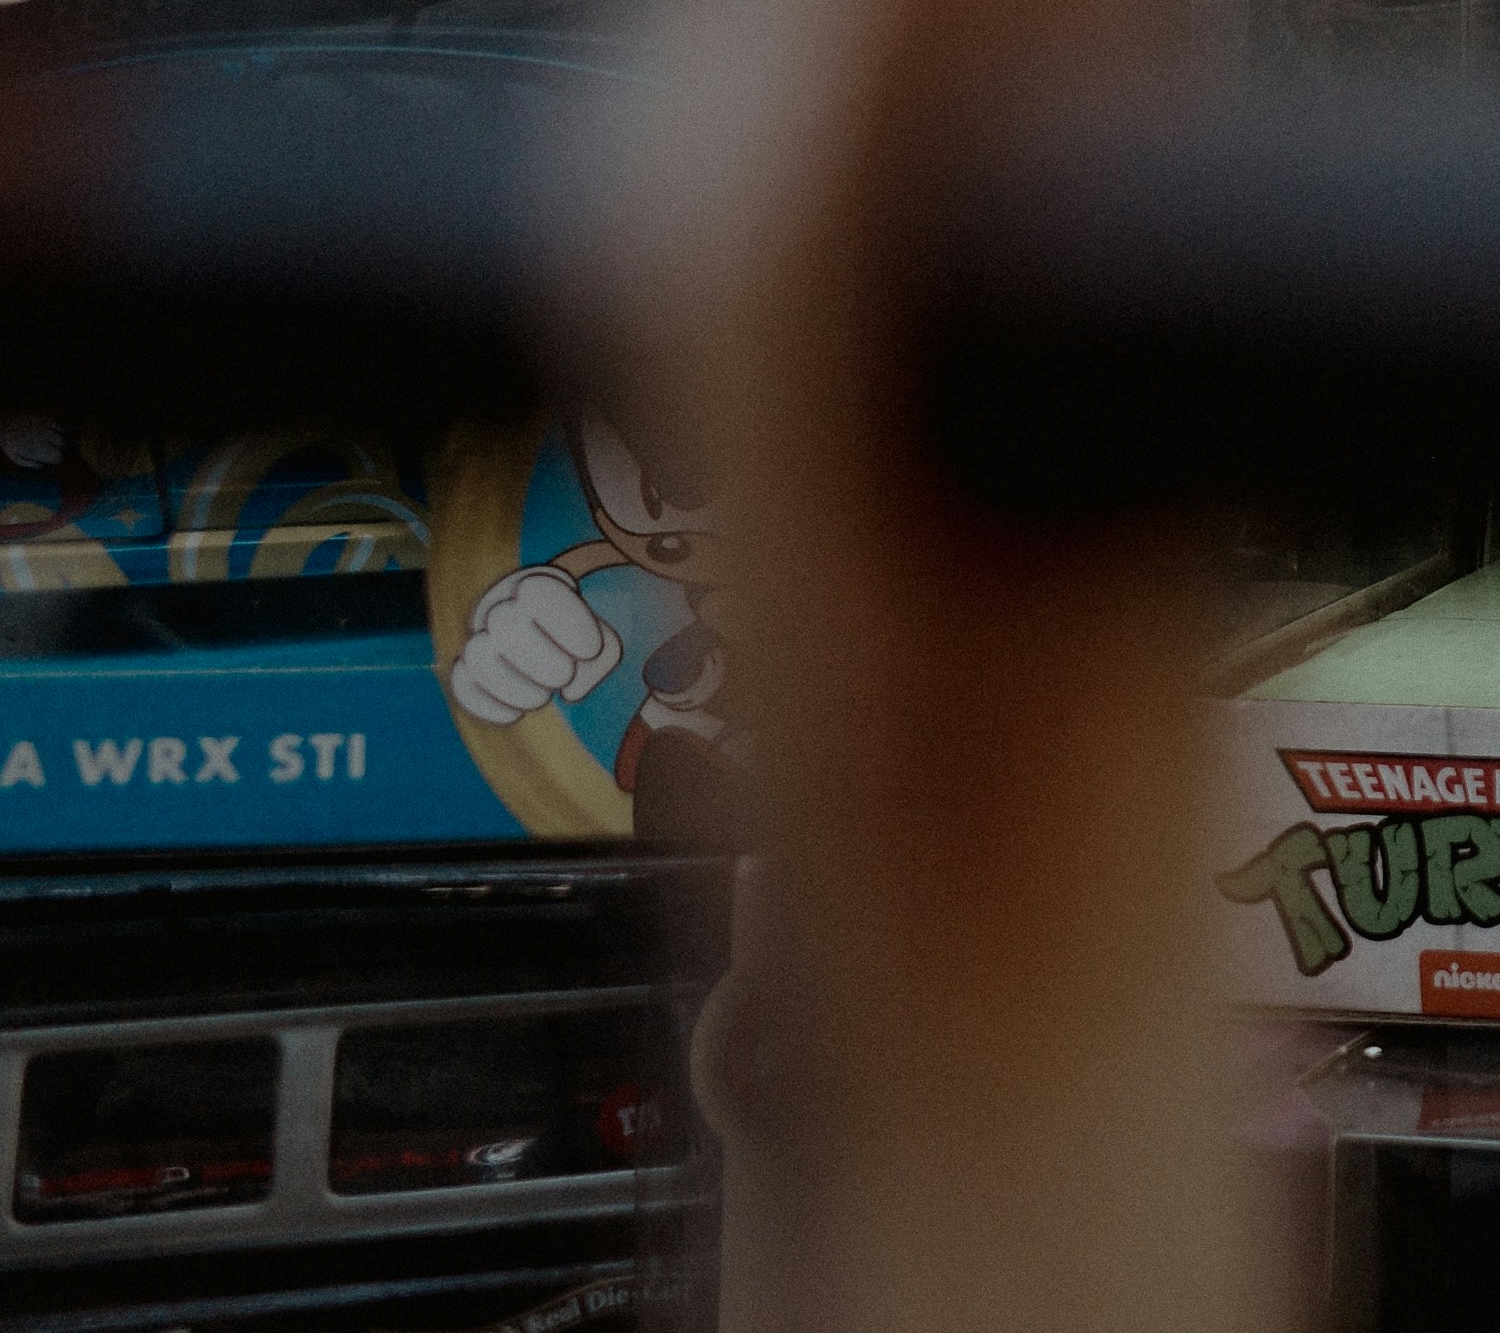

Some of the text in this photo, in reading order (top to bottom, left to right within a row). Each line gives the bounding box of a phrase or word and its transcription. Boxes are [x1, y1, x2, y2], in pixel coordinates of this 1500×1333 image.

[71, 734, 243, 787] WRX
[267, 730, 368, 782] STI
[1297, 759, 1489, 807] TEENAGE
